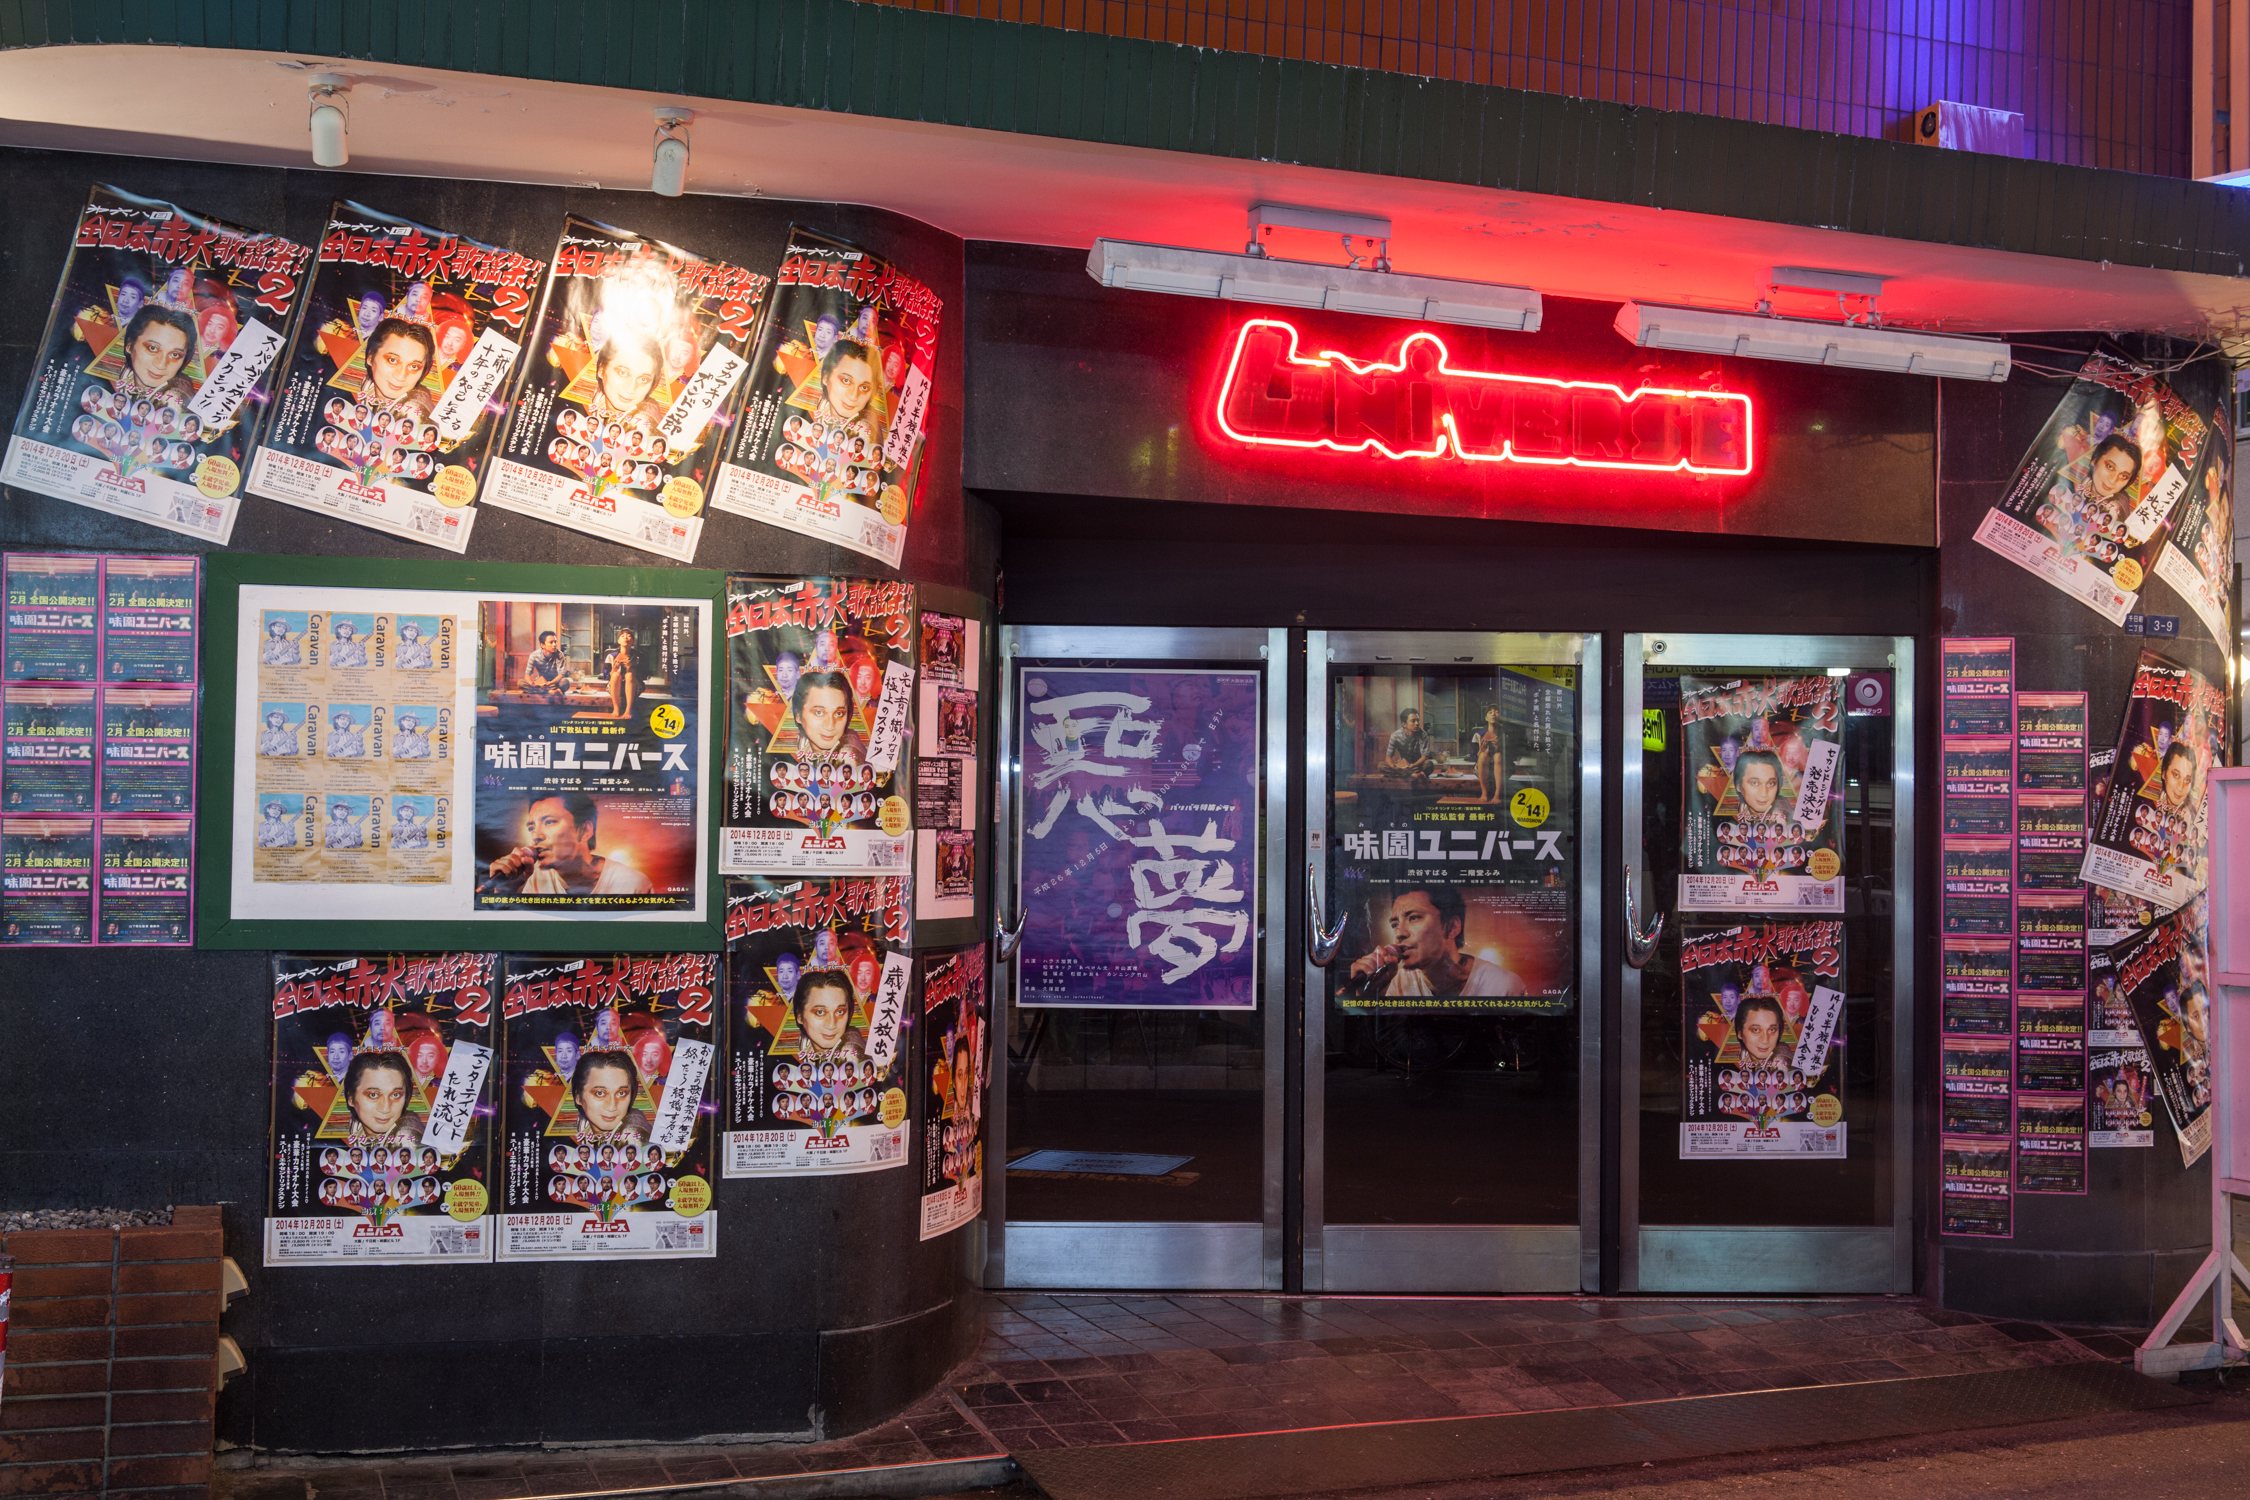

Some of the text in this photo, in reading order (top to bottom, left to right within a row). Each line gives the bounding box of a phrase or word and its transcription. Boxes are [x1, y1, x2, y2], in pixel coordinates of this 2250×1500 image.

[99, 472, 144, 491] ユニバース
[341, 482, 386, 501] ユニバース
[572, 492, 616, 511] ユニバース
[800, 494, 840, 516] ユニバース
[10, 596, 26, 605] 2月
[109, 598, 125, 607] 2月
[9, 615, 94, 628] 味園ユニバース
[109, 617, 191, 629] 味園ユニバース
[2154, 621, 2173, 632] 3-9
[2128, 624, 2144, 632] 二丁目
[310, 614, 322, 665] Caravan
[376, 616, 388, 667] Caravan
[441, 618, 453, 669] Caravan
[1947, 684, 2009, 693] 味園ユニバース
[8, 727, 23, 736] 2月
[107, 728, 122, 736] 2月
[307, 705, 320, 757] Caravan
[373, 707, 386, 758] Caravan
[439, 708, 451, 759] Caravan
[602, 726, 626, 735] 最新作
[2020, 738, 2082, 748] 味園ユニバース
[7, 746, 91, 758] 味園ユニバース
[107, 747, 189, 759] 味園ユニバース
[484, 741, 690, 771] 味園ユニバース
[1800, 766, 1822, 821] 発売決定
[305, 796, 318, 847] Caravan
[371, 797, 384, 849] Caravan
[1414, 813, 1495, 821] 山下敦弘監督 最新作
[437, 798, 449, 849] Caravan
[1312, 833, 1320, 841] 押
[804, 839, 844, 848] ユニバース
[1344, 831, 1565, 860] 味園ユニバース
[5, 859, 21, 867] 2月
[105, 859, 120, 867] 2月
[1460, 869, 1500, 877] 二階堂ふみ
[4, 877, 89, 889] 味園ユニバース
[104, 877, 186, 889] 味園ユニバース
[1744, 882, 1778, 891] ユニバース
[874, 965, 905, 1058] 歳末大放出
[1746, 1129, 1779, 1138] ユニバース
[808, 1138, 848, 1149] ユニバース
[356, 1227, 401, 1237] ユニバース
[584, 1222, 628, 1233] ユニバース
